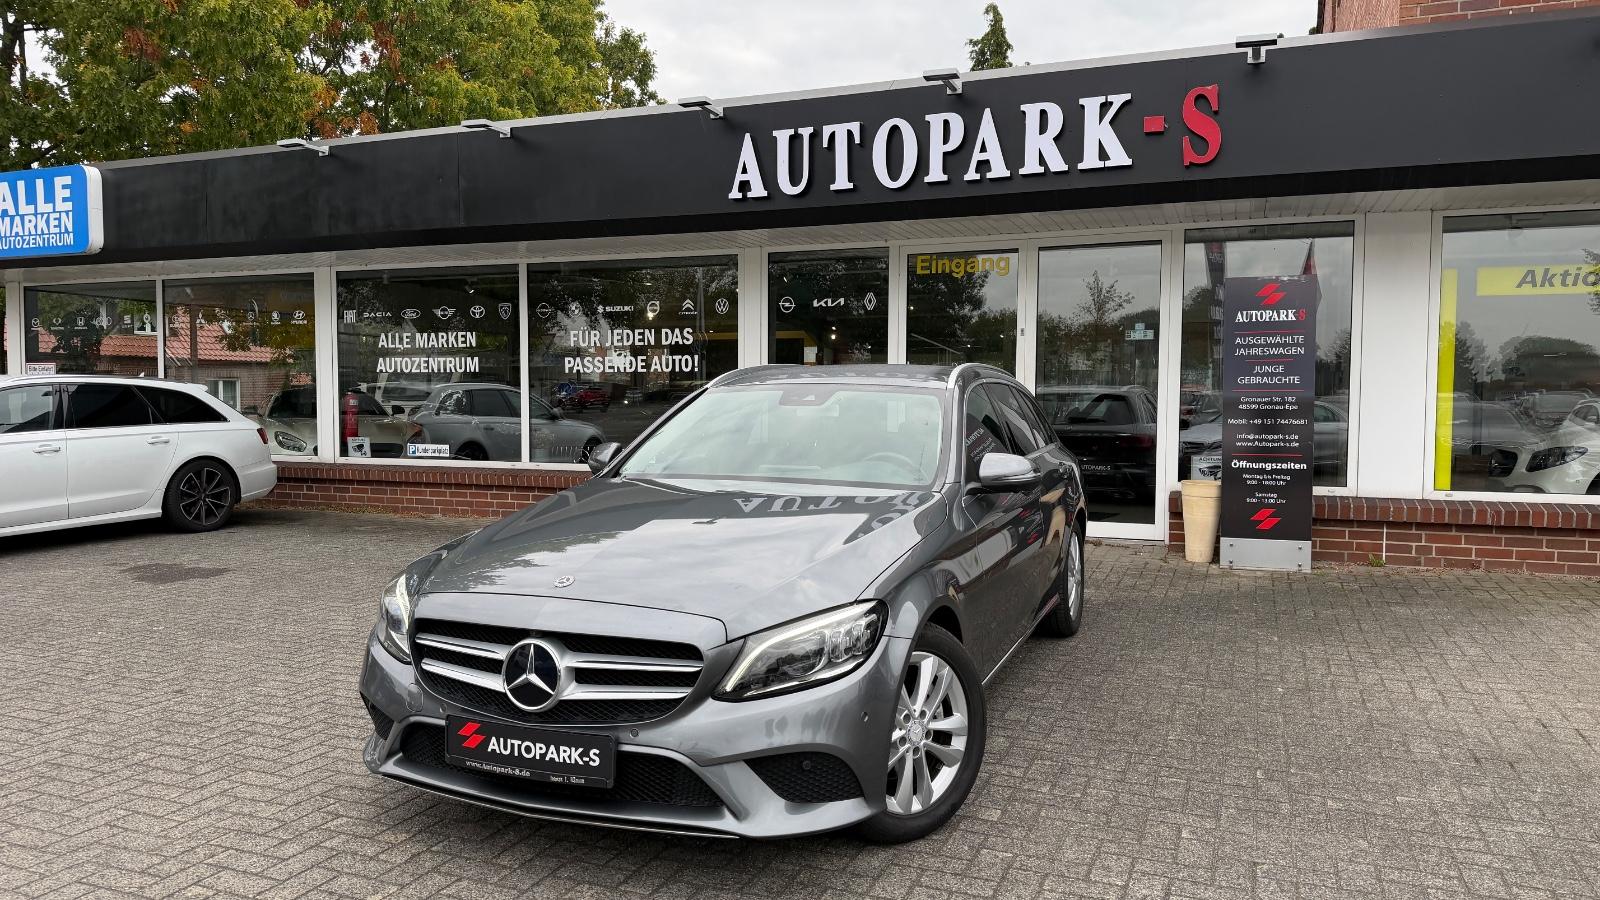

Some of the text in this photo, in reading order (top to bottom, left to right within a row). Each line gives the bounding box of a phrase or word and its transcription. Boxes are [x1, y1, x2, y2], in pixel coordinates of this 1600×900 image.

[0, 176, 72, 215] ALLE
[0, 211, 73, 237] MARKEN
[916, 255, 1010, 278] Eingang
[378, 331, 477, 348] ALLE MARKEN
[569, 326, 694, 347] FÜR JEDEN DAS
[1234, 335, 1305, 345] AUSGEWÄHLTE
[1234, 347, 1305, 356] JAHRESWAGEN
[376, 356, 480, 374] AUTOZENTRUM
[564, 354, 699, 374] PASSENDE AUTO!
[1253, 365, 1285, 373] JUNGE
[1237, 376, 1301, 384] GEBRAUCHTE
[1231, 459, 1307, 471] Öffnungszeiten
[487, 736, 601, 767] AUTOPARK-S
